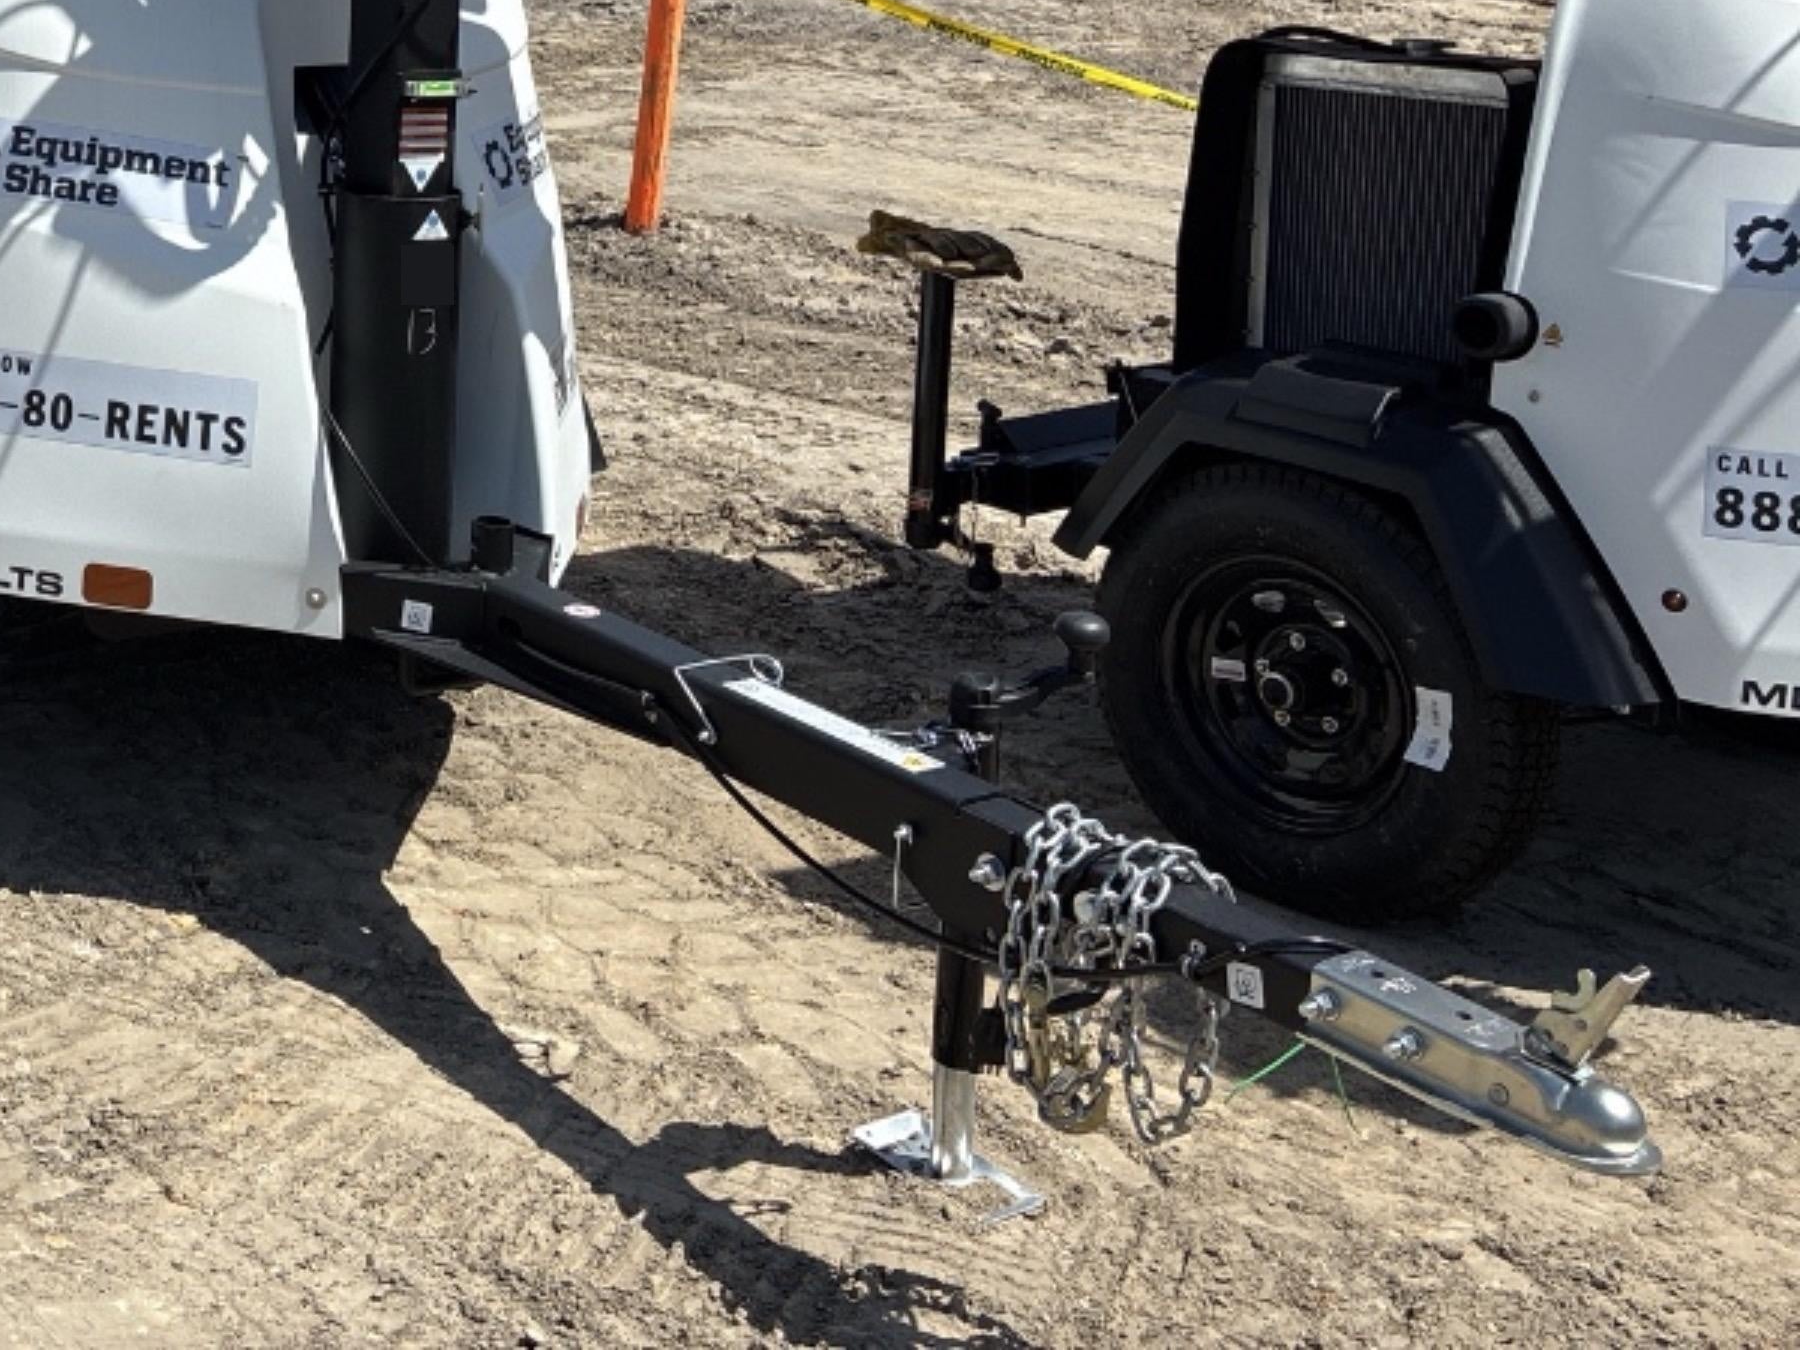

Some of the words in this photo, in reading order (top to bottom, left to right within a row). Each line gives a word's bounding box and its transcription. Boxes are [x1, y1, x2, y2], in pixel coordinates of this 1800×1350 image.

[8, 124, 233, 188] Equipment
[3, 163, 119, 206] Share
[1717, 453, 1789, 479] CALL
